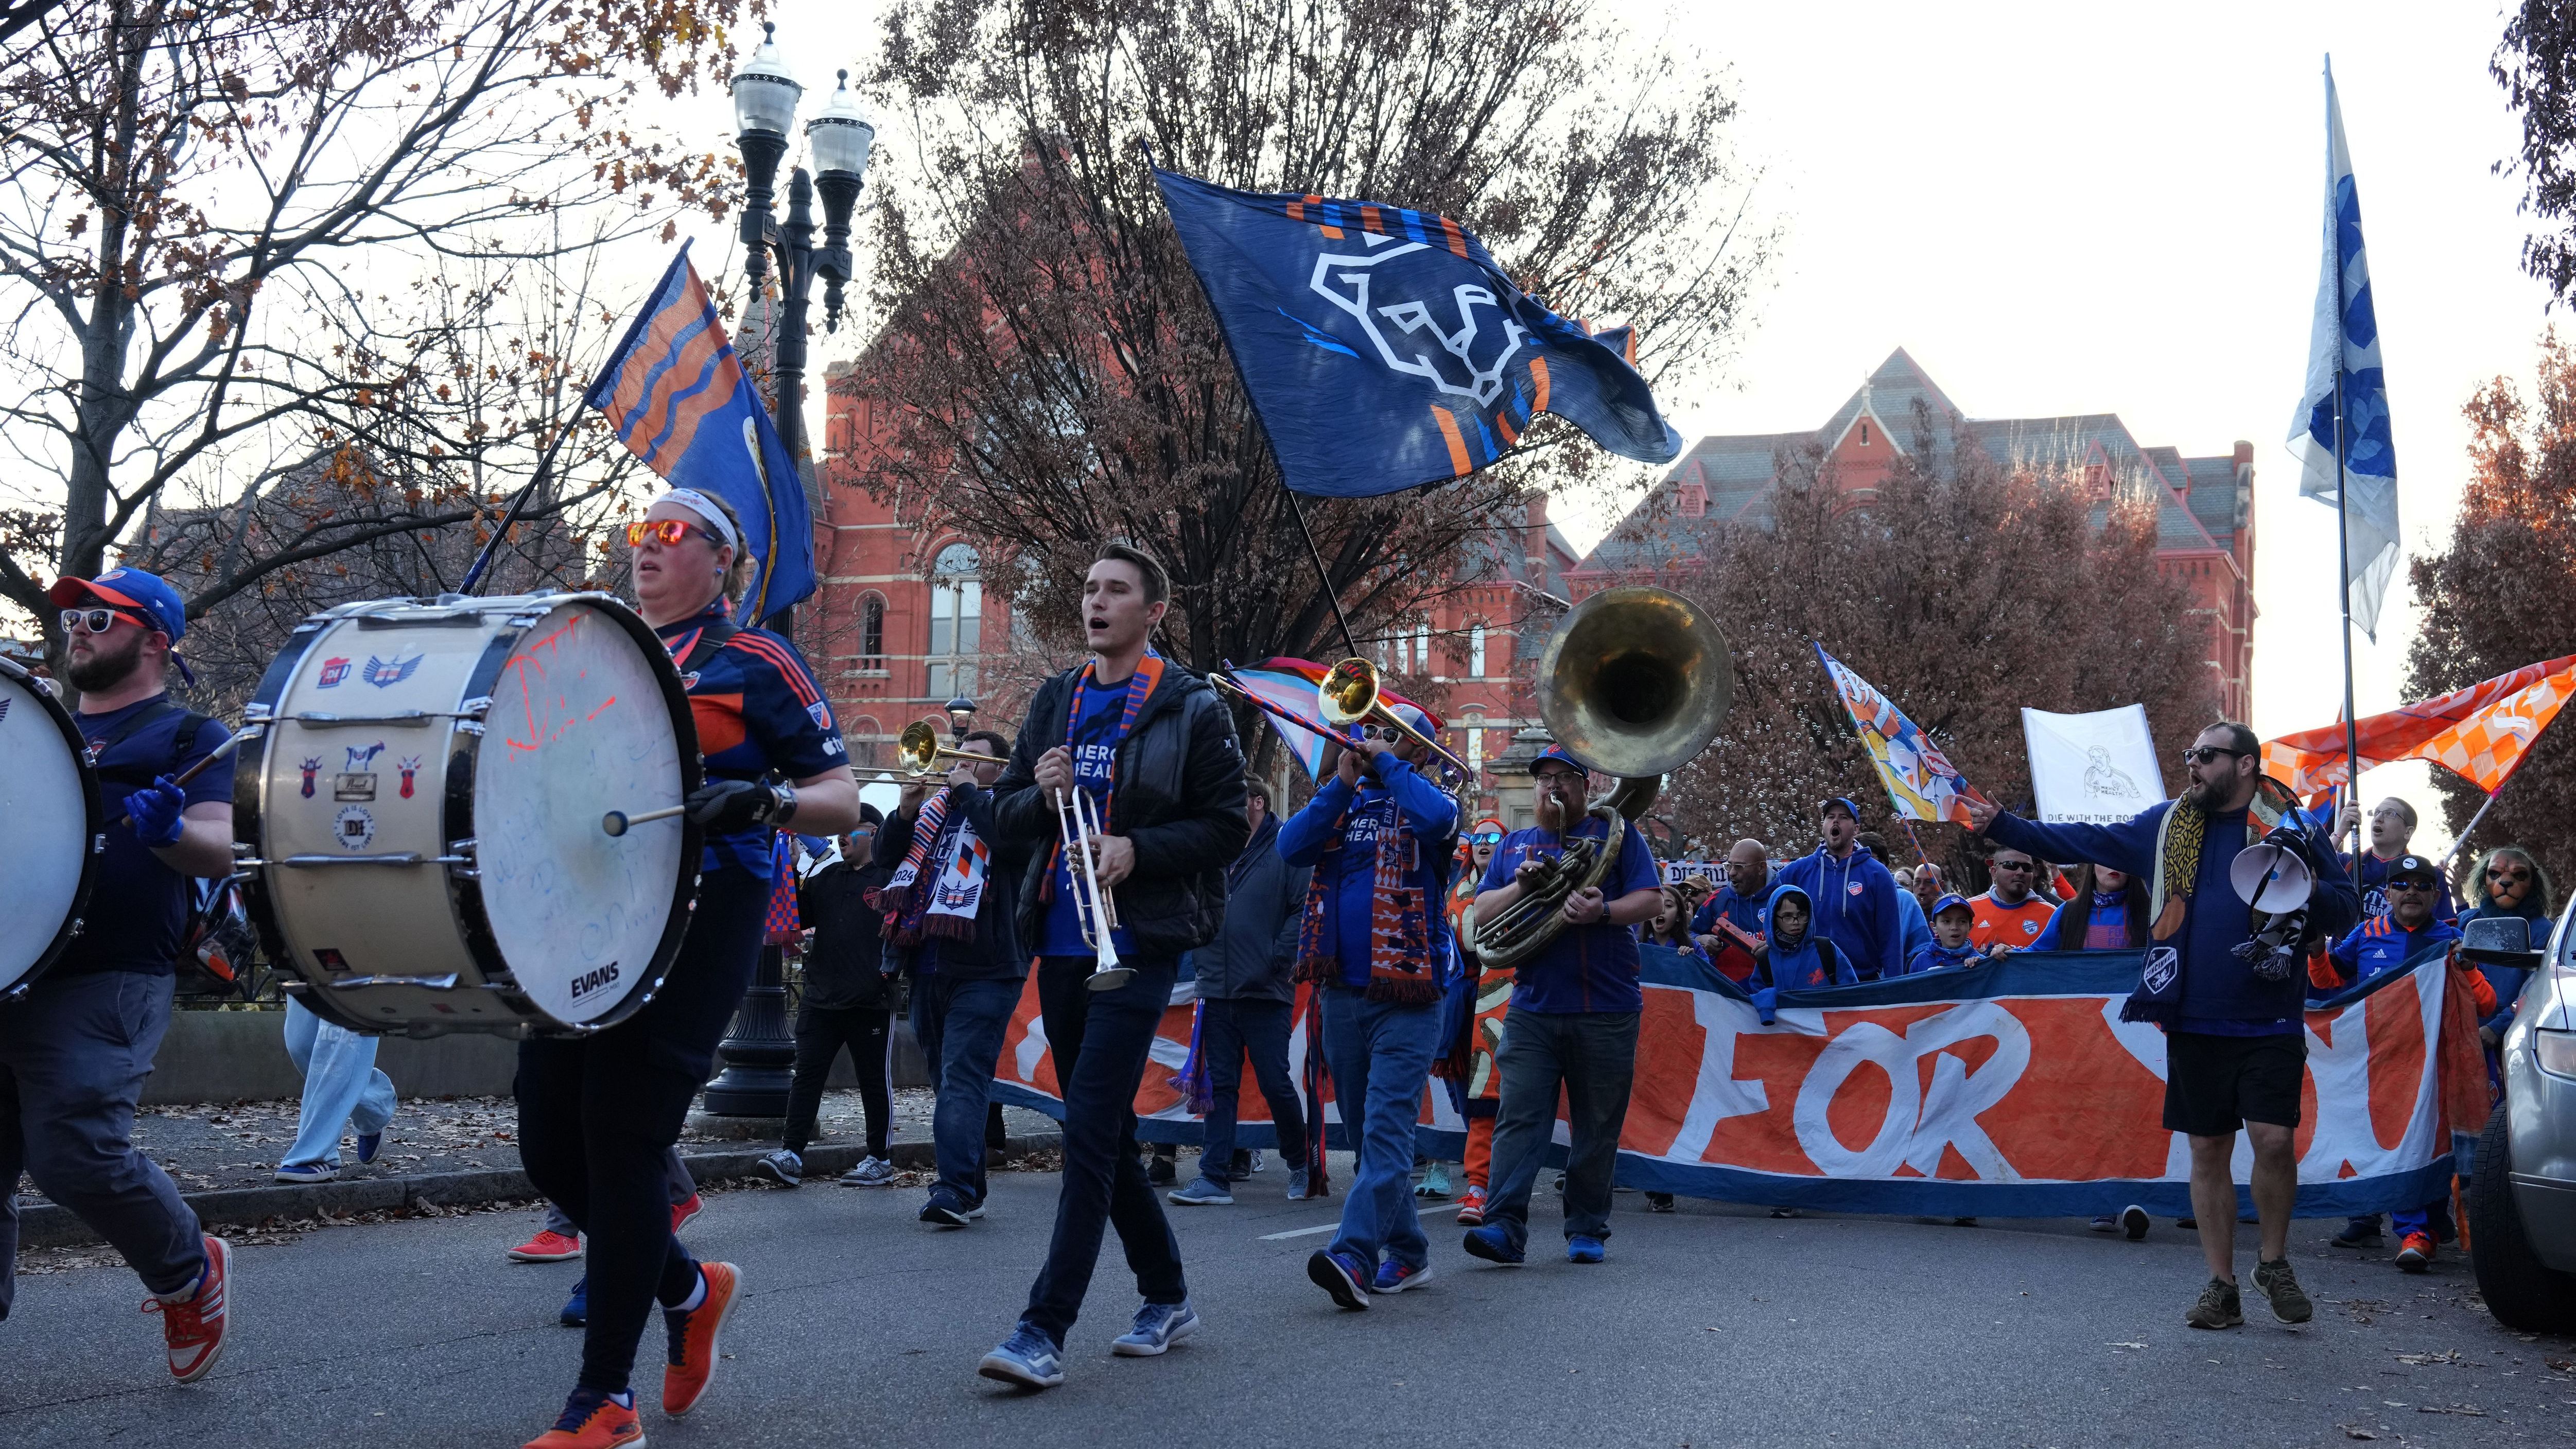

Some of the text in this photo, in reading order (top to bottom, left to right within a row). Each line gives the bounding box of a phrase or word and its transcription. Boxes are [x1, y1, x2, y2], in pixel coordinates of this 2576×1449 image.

[1384, 808, 1393, 825] EIN
[2146, 951, 2175, 979] CINCINNATI
[2151, 952, 2156, 962] FC
[571, 960, 619, 999] EVANS
[1666, 989, 2031, 1180] FOR
